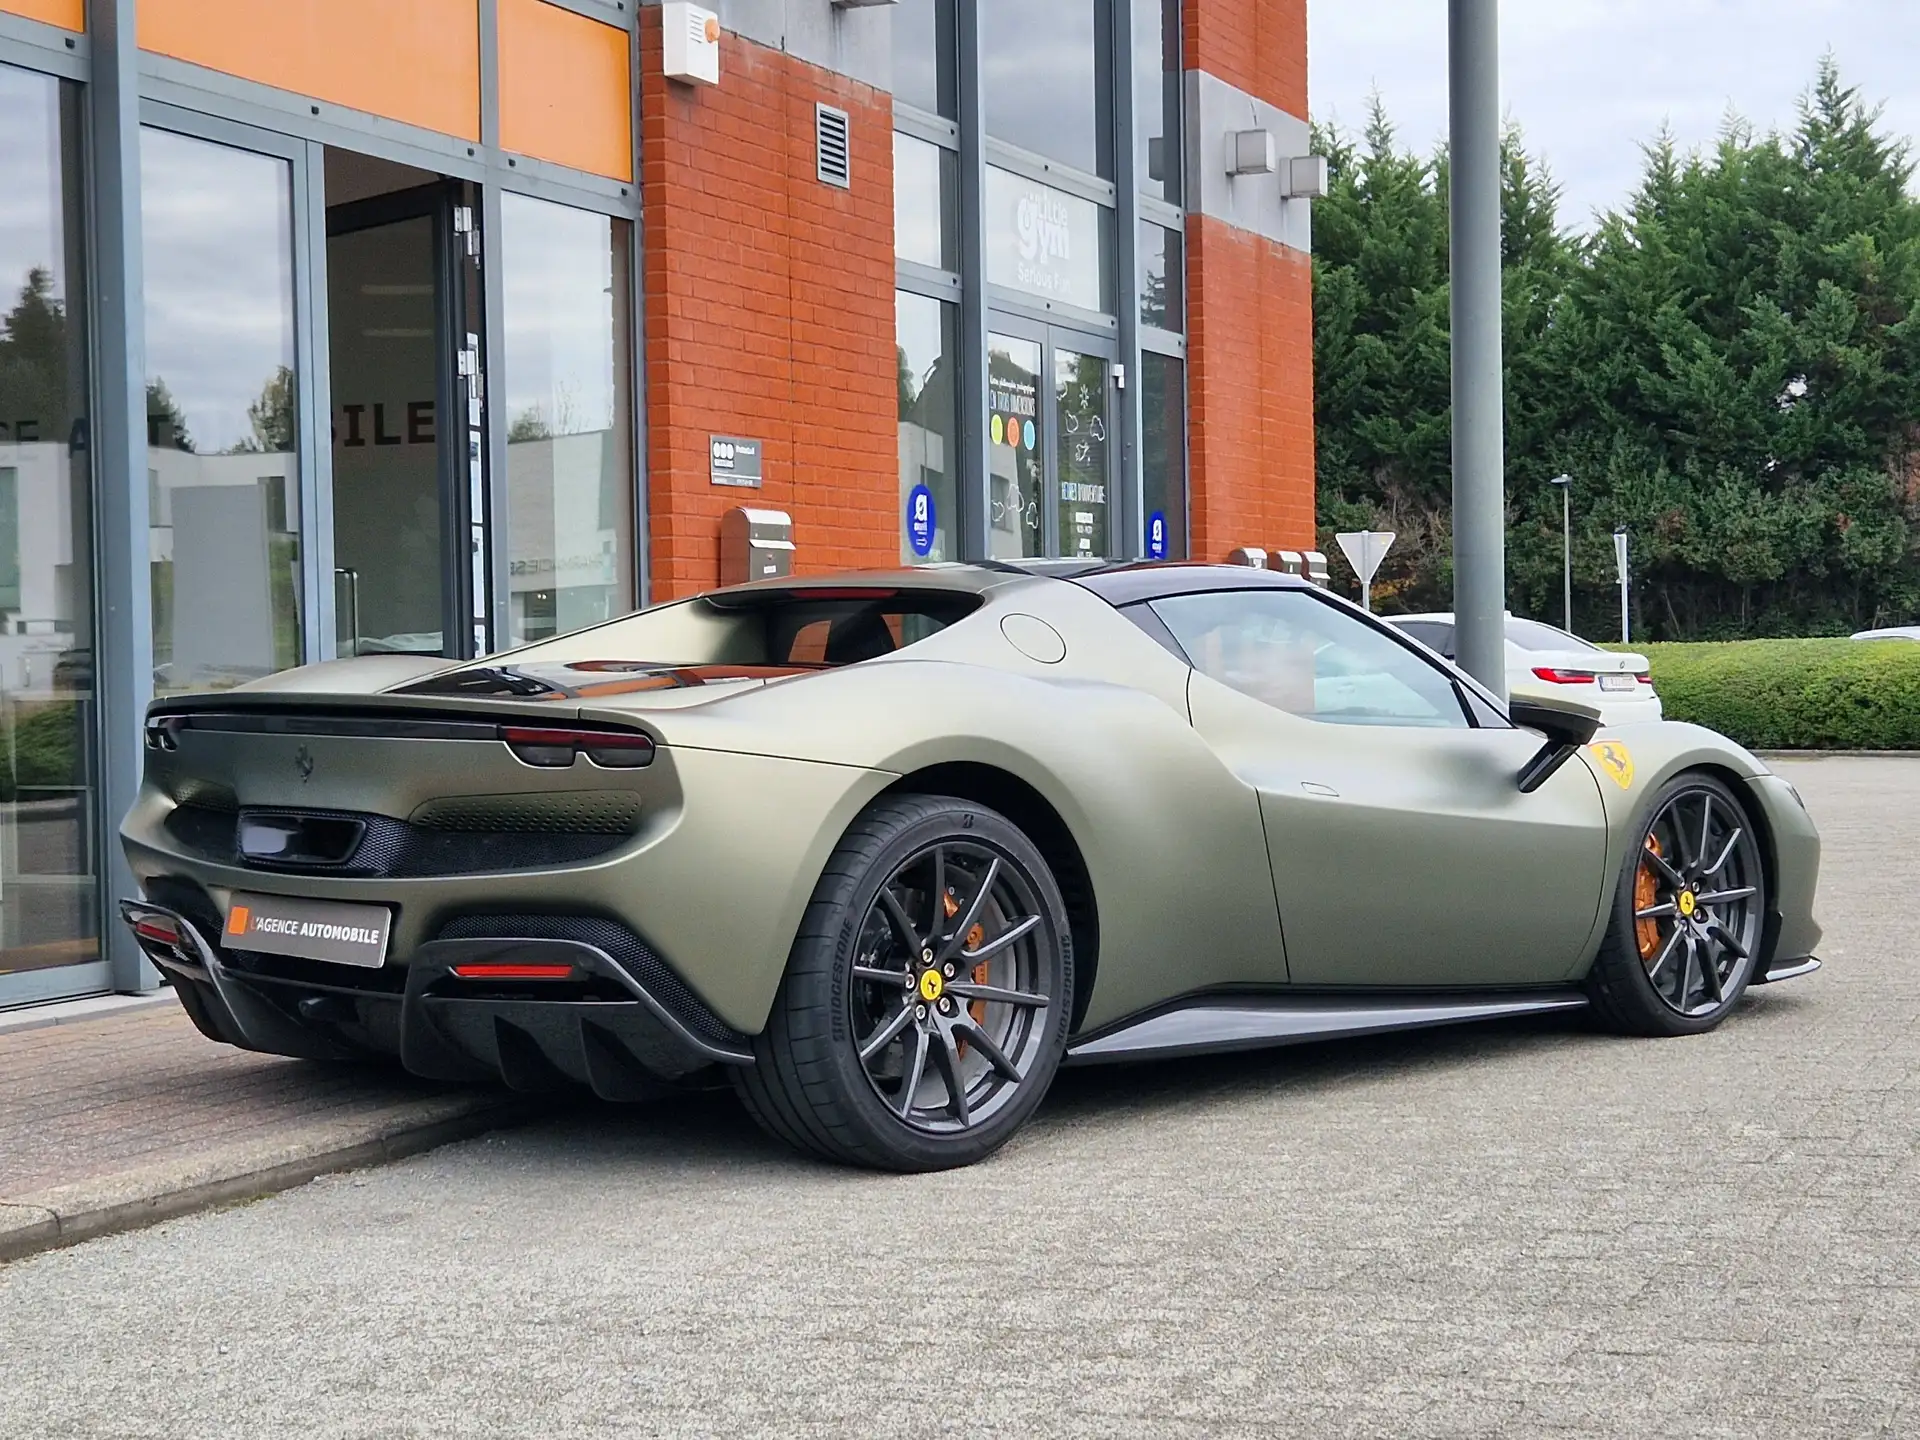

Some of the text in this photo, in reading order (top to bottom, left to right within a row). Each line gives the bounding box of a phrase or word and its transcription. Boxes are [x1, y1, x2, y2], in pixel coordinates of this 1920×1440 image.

[1017, 198, 1070, 265] gym
[1017, 261, 1053, 289] Serious
[332, 400, 436, 447] ILE
[299, 922, 380, 944] AUTOMOBILE
[830, 917, 854, 1042] BRIDGESTONE
